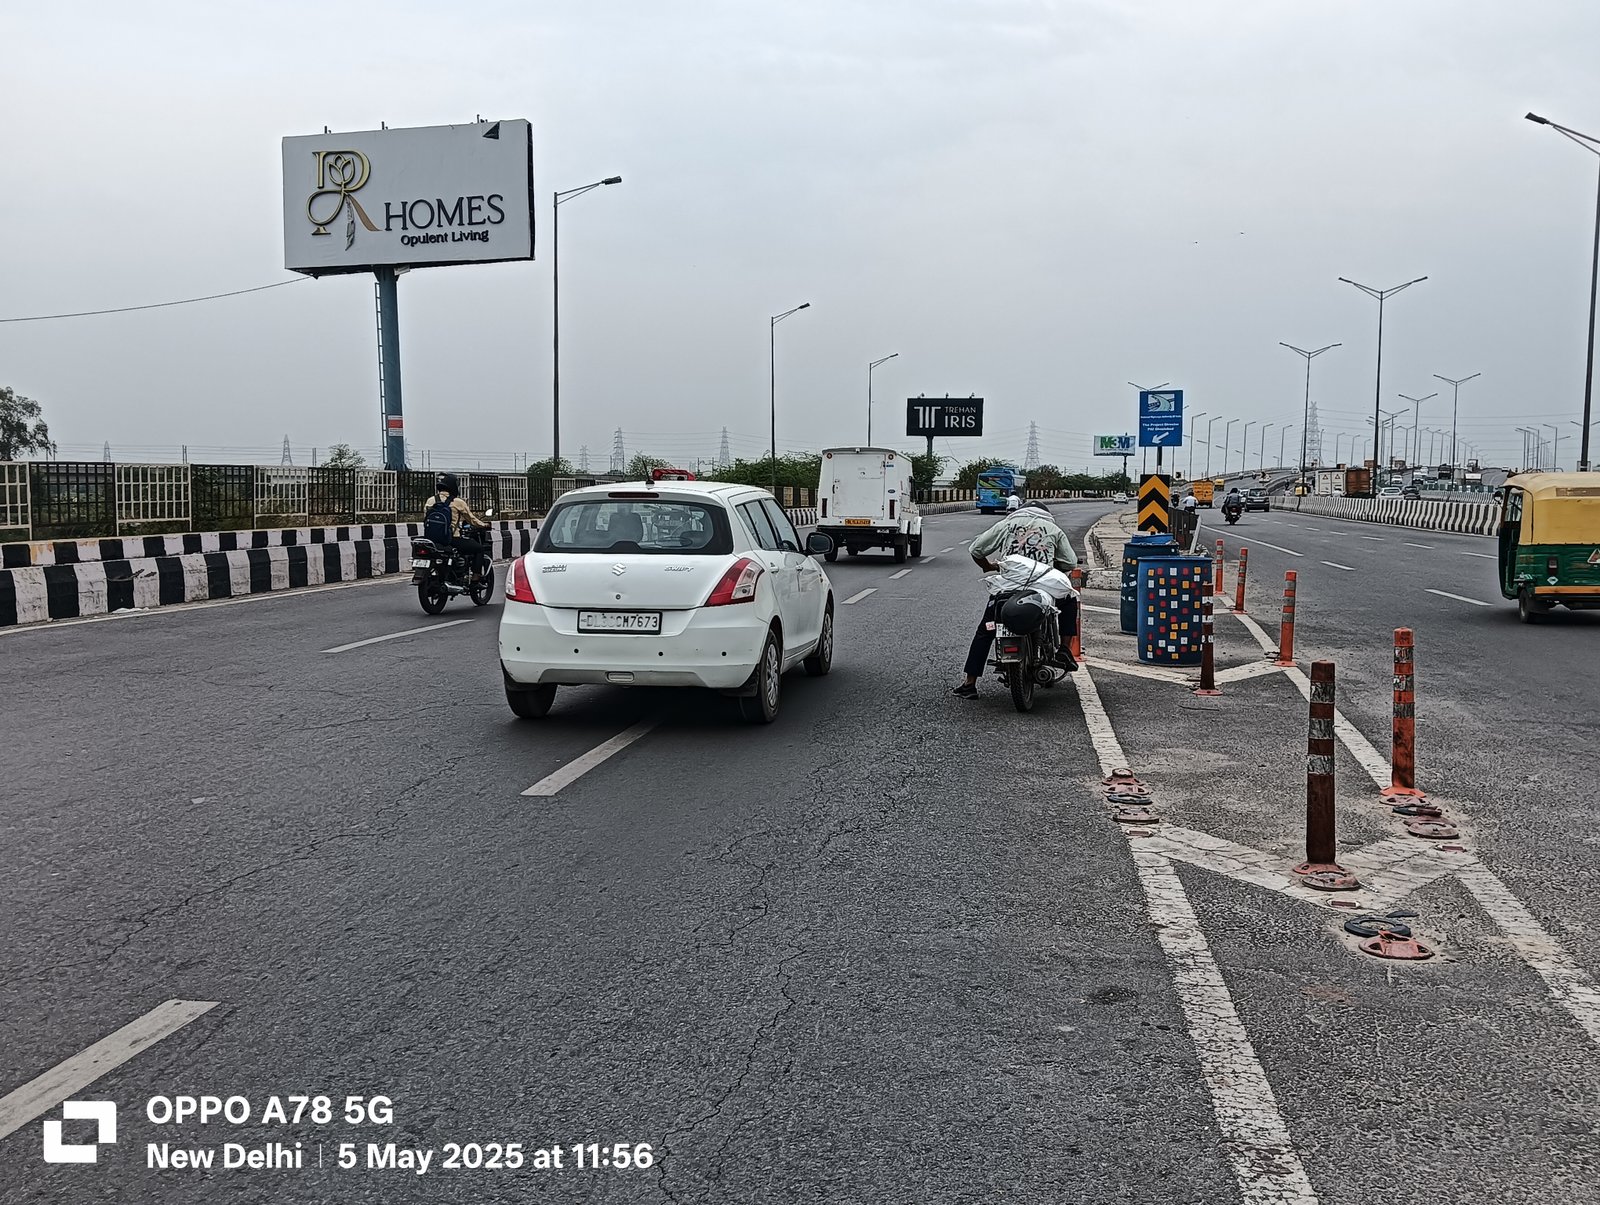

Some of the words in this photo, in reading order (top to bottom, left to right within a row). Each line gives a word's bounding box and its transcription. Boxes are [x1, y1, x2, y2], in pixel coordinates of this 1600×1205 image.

[384, 194, 505, 231] HOMES
[401, 232, 448, 247] Opulent
[452, 229, 489, 243] Living
[945, 415, 976, 428] IRIS
[1100, 436, 1130, 449] M3M
